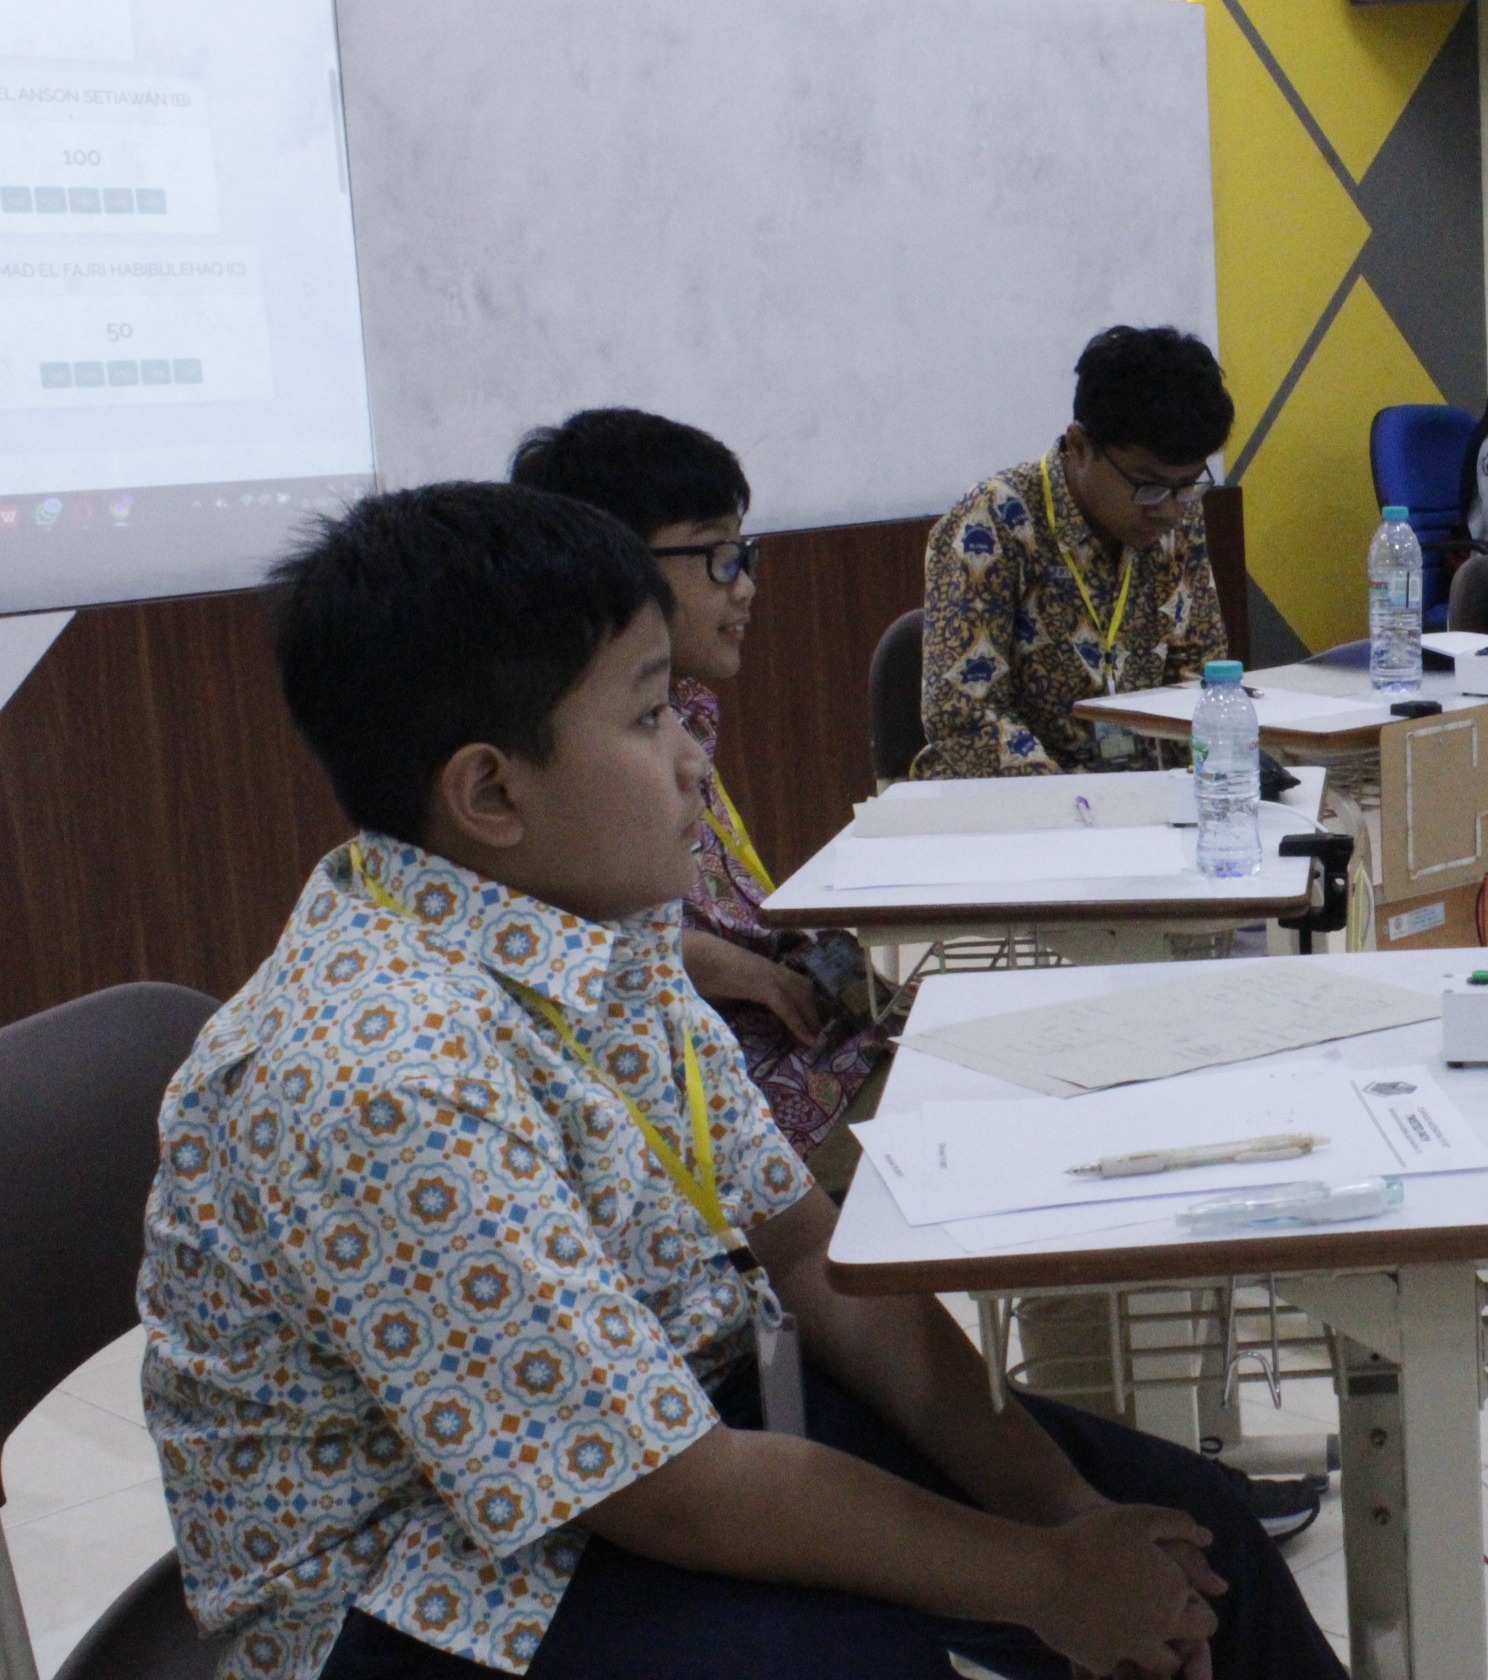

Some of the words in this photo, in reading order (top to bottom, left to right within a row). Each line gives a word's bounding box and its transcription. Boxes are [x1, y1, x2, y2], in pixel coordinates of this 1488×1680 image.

[18, 87, 79, 103] ANSON
[83, 89, 167, 106] SETIAWAN
[63, 149, 101, 166] 100
[39, 262, 60, 278] EL
[62, 262, 106, 278] FAJRI
[226, 261, 246, 277] (C)
[106, 322, 133, 343] 50
